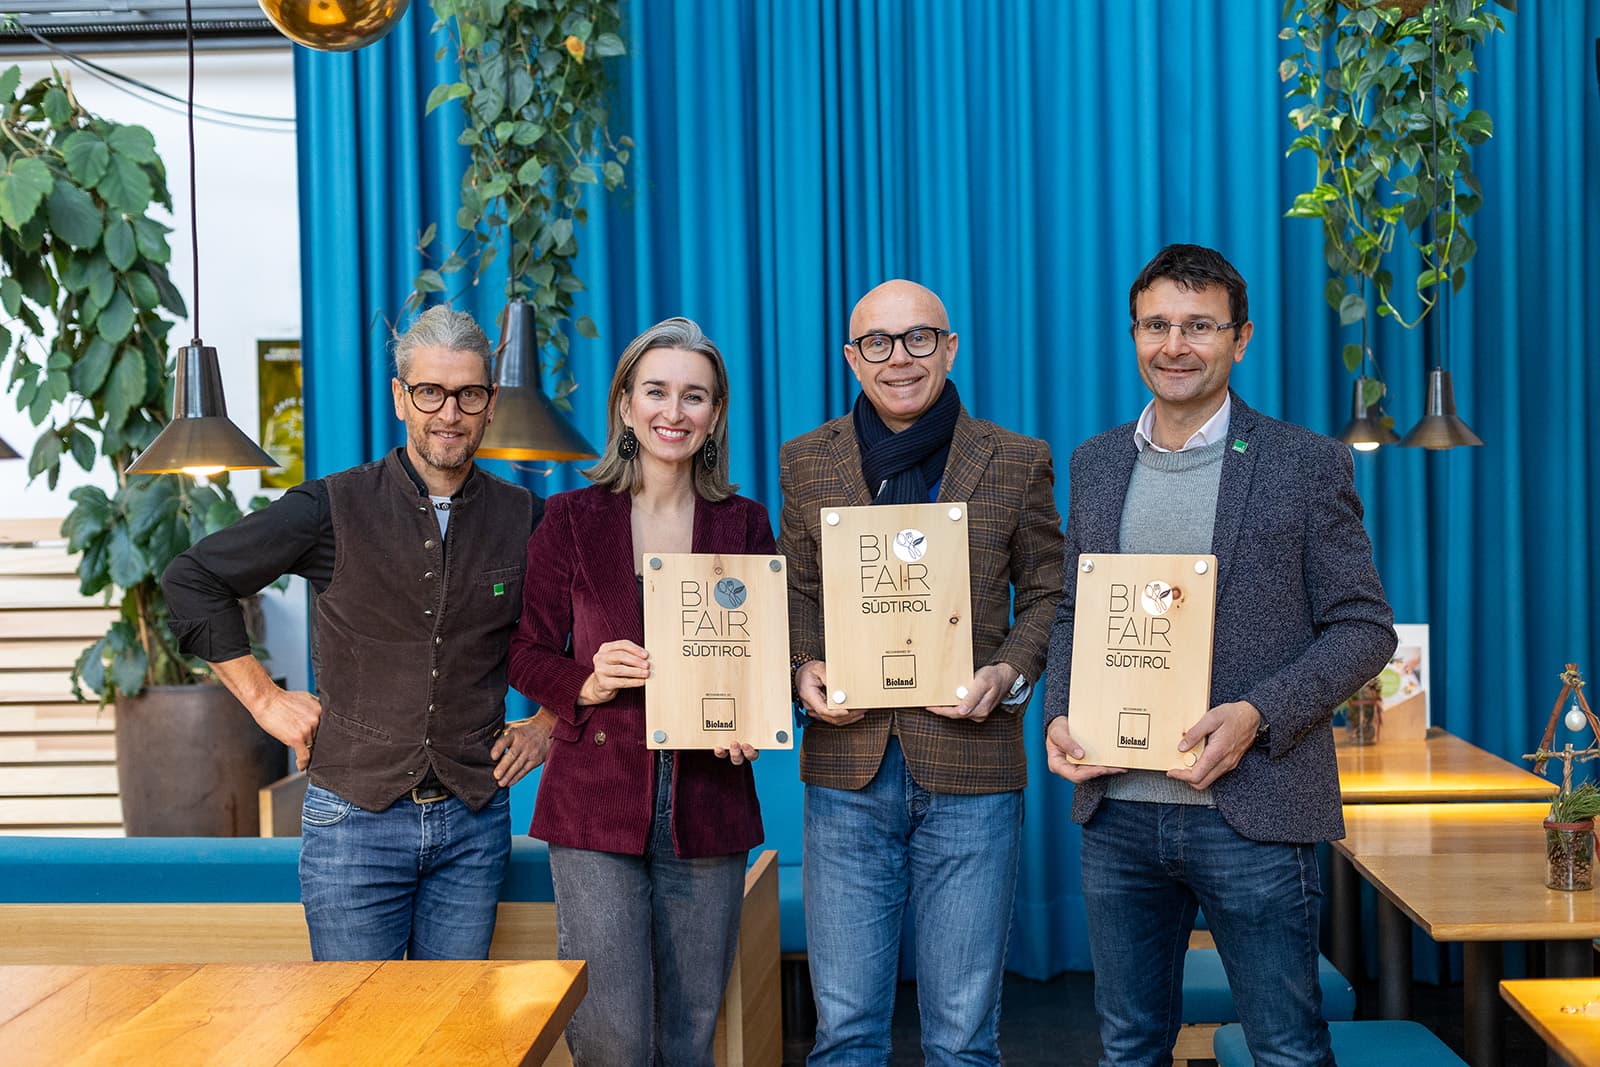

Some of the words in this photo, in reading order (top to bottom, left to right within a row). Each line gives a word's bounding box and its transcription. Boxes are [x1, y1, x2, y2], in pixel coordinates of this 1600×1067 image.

[860, 563, 931, 593] FAIR
[861, 599, 932, 615] SÜDTIROL
[681, 609, 751, 637] FAIR
[1107, 615, 1172, 647] FAIR
[682, 642, 752, 658] SÜDTIROL
[1105, 651, 1171, 670] SÜDTIROL
[885, 677, 914, 687] Bioland
[705, 719, 734, 729] Bioland
[1120, 735, 1147, 747] Bioland
